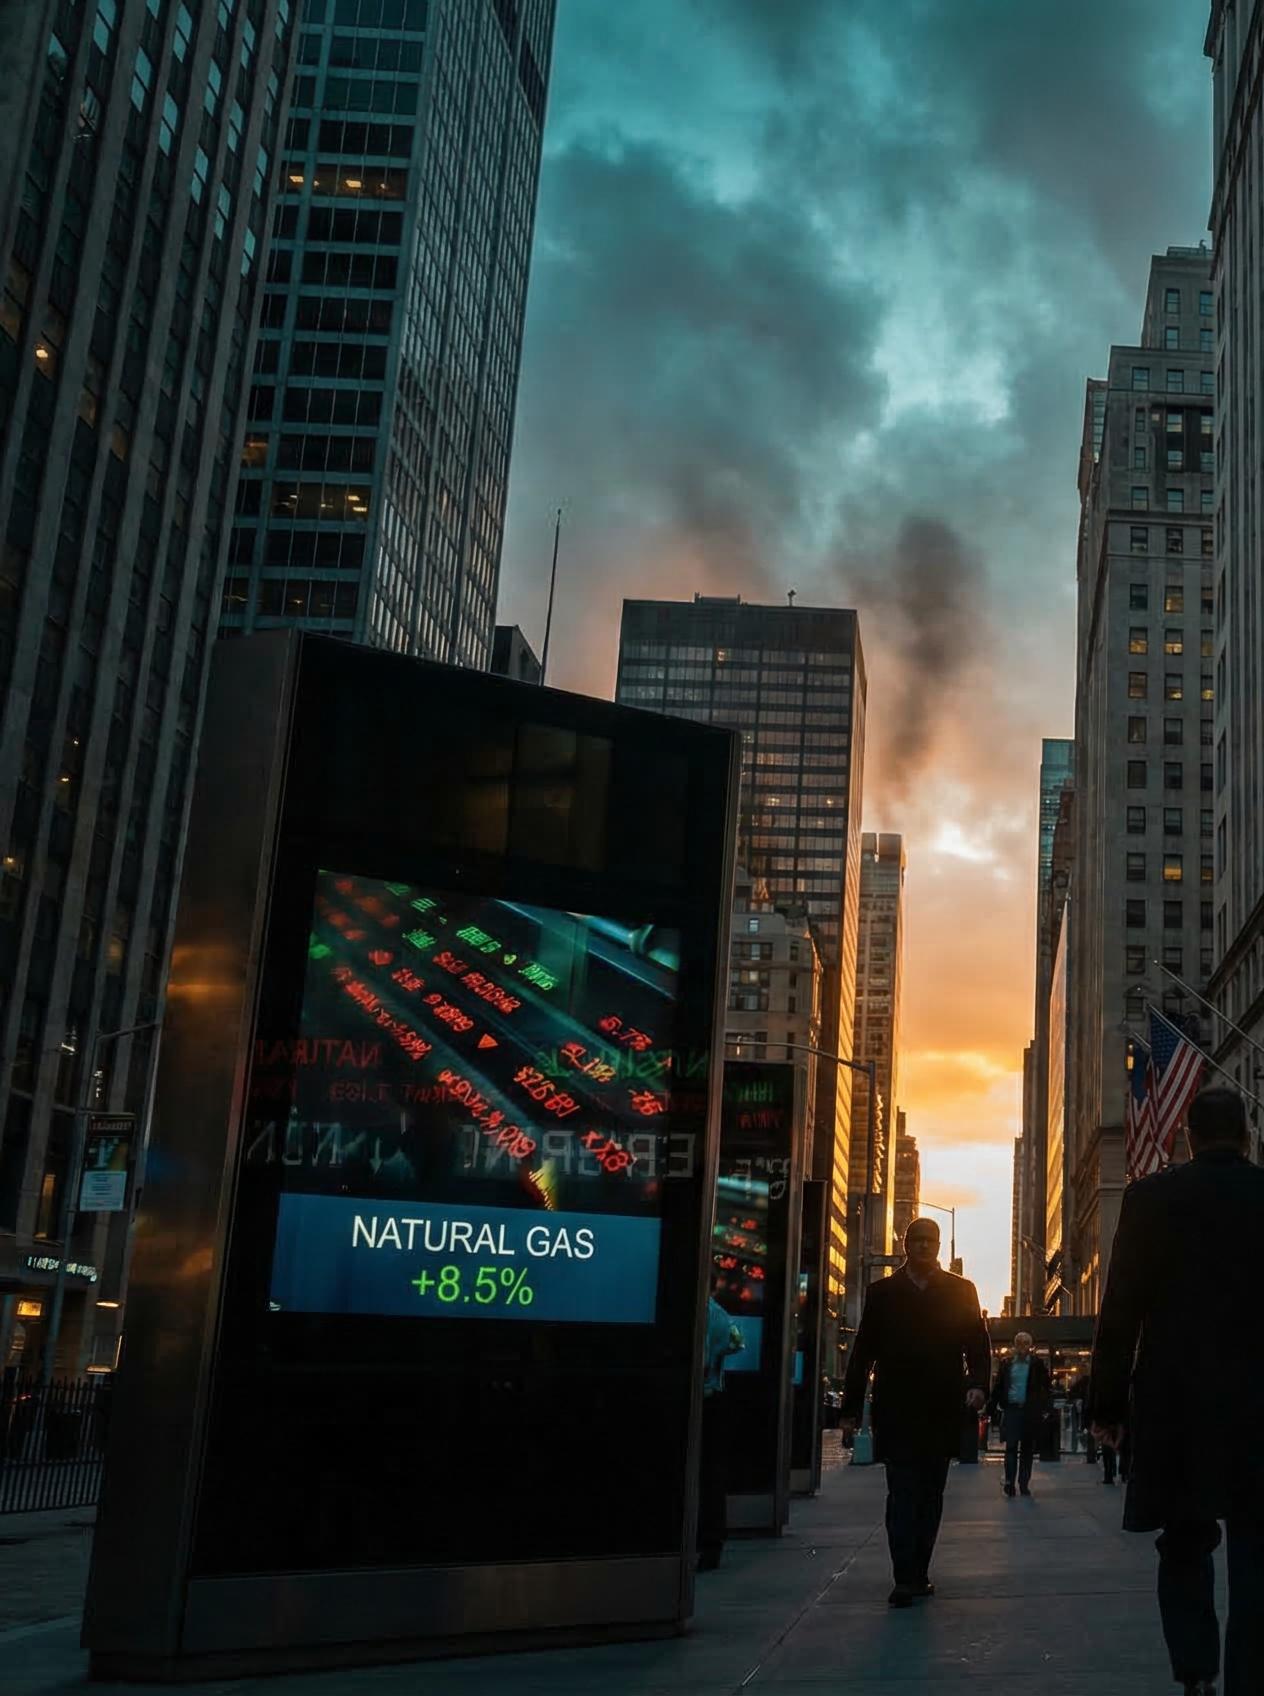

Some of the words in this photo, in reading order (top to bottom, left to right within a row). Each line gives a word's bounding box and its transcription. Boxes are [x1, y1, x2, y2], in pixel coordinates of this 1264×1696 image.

[351, 1214, 516, 1257] NATURAL
[526, 1225, 596, 1259] GAS
[411, 1266, 535, 1306] +8.5%
